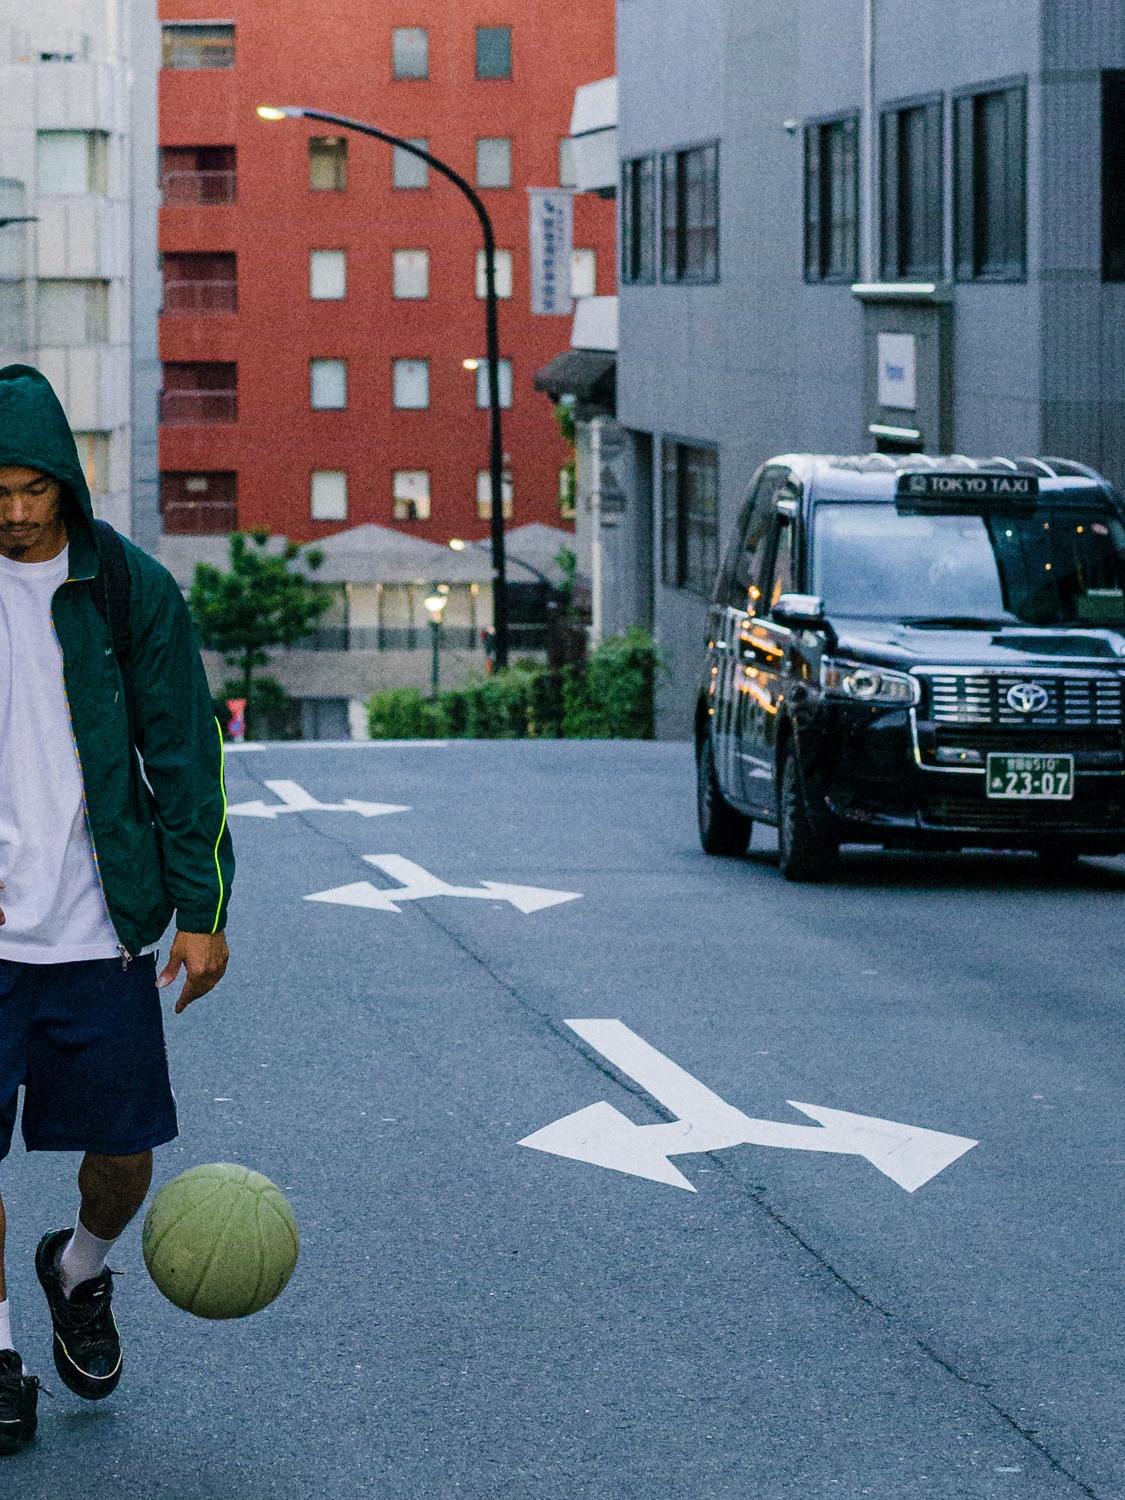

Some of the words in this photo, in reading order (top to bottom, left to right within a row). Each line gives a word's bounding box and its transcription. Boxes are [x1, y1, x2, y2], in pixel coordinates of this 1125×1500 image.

[930, 475, 987, 493] TOKYO
[990, 477, 1029, 493] TAXI
[1005, 771, 1069, 796] 23-07
